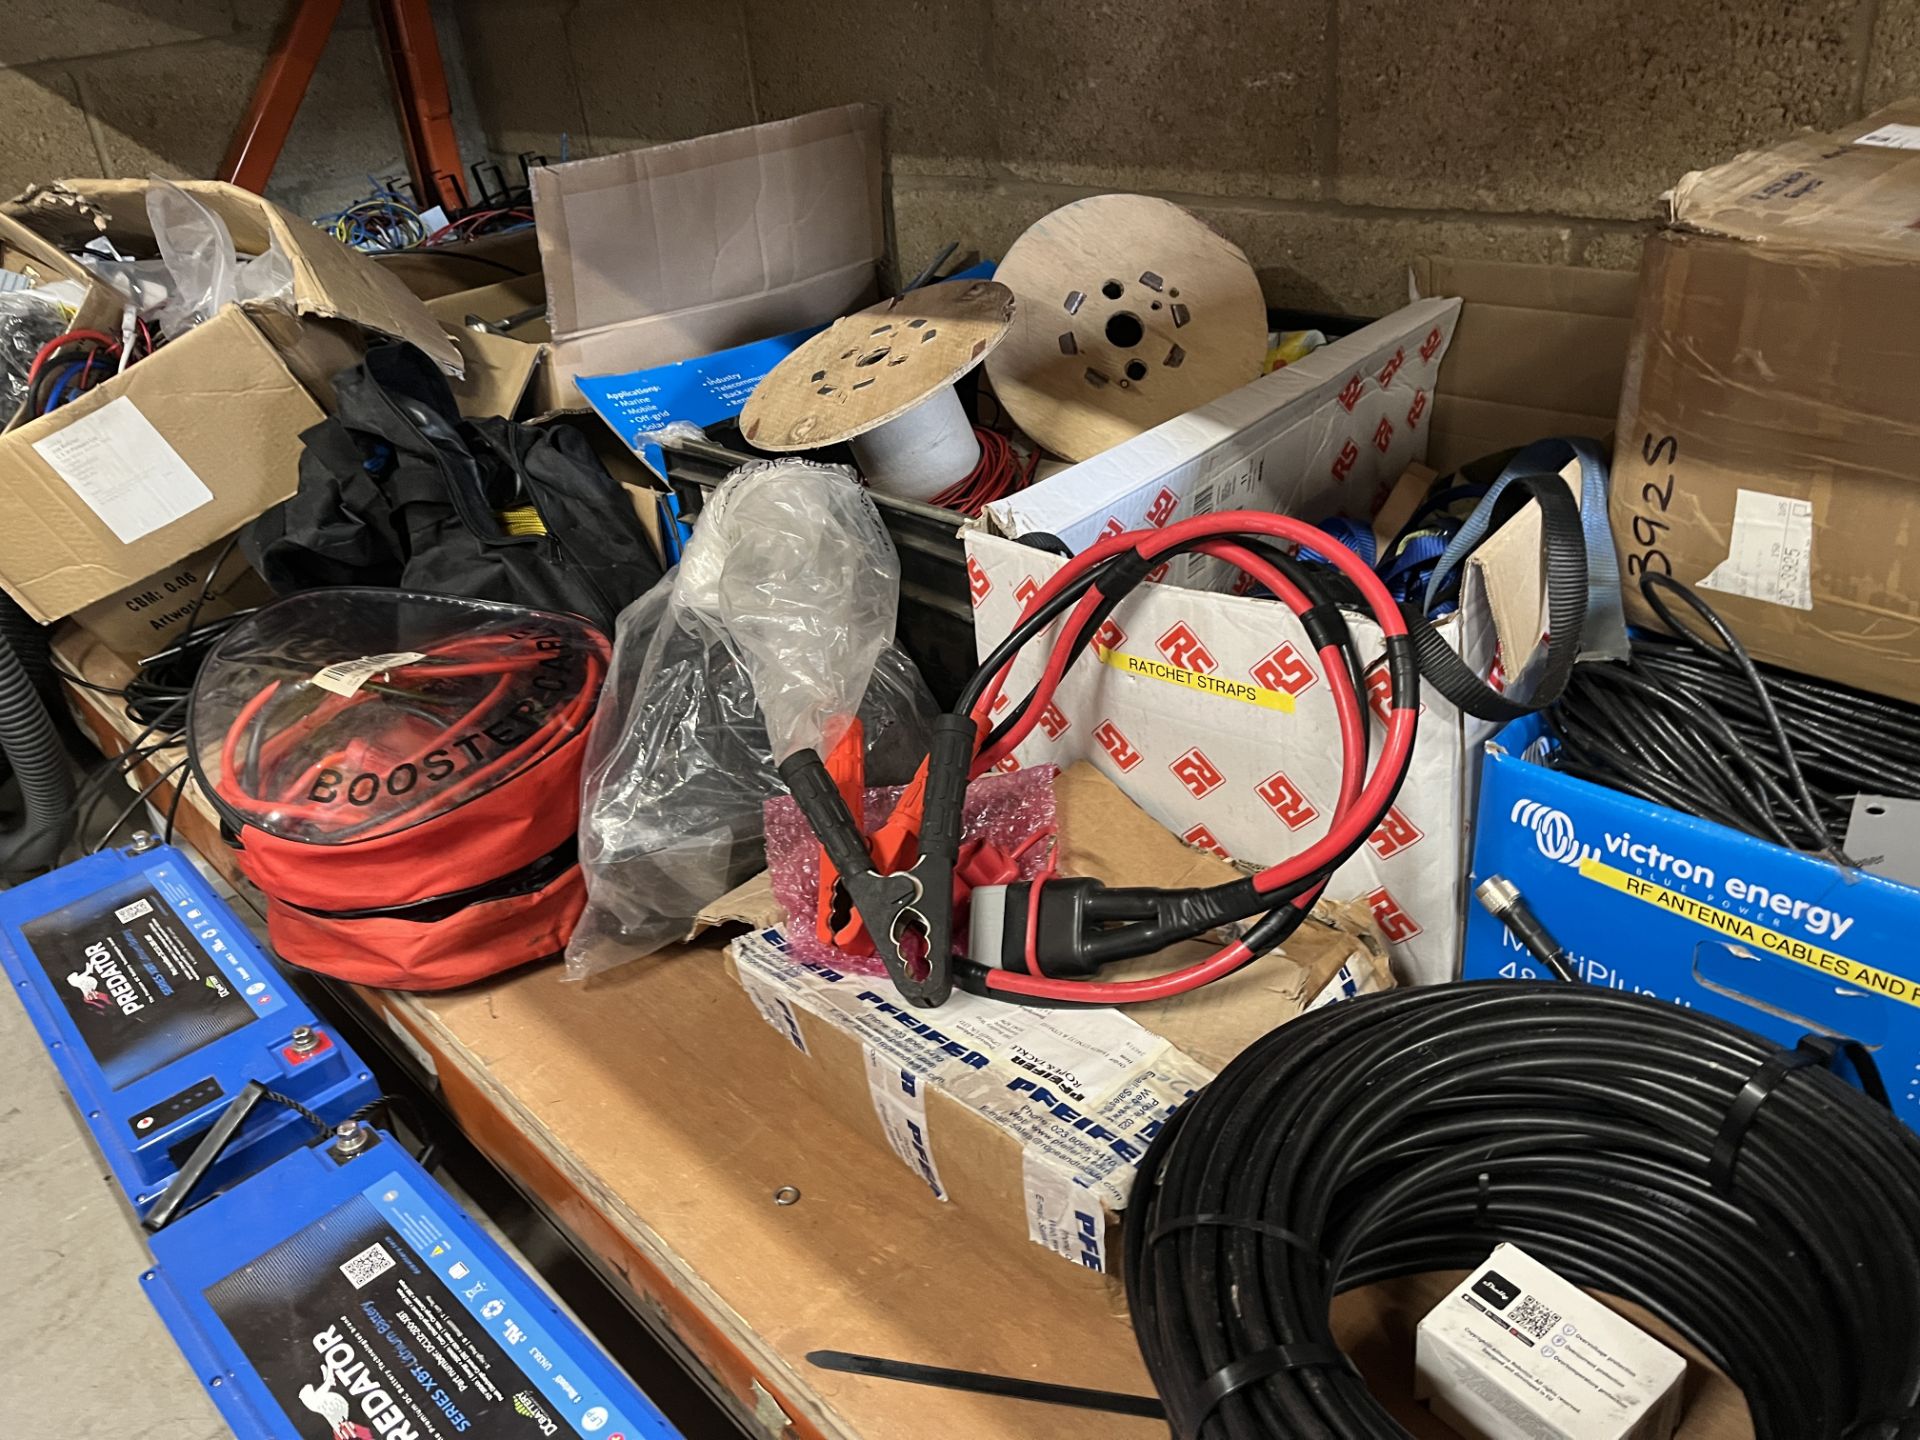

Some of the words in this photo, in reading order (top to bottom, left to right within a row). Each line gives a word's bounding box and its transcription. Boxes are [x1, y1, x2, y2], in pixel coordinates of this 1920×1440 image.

[606, 385, 661, 400] Applications:
[620, 396, 651, 407] Marine
[628, 403, 658, 415] Mobile
[635, 411, 670, 423] Off-grid
[642, 421, 666, 431] Solar
[1330, 439, 1359, 482] RS
[164, 571, 198, 594] 0.06
[1129, 657, 1193, 685] RATCHET
[1197, 673, 1257, 701] STRAPS
[1253, 643, 1316, 696] RS
[306, 699, 542, 808] BOOSTER
[1097, 721, 1141, 770] RS
[1172, 749, 1224, 798] RS
[1258, 774, 1317, 829] RS
[1604, 831, 1715, 889] victron
[1724, 876, 1855, 941] energy
[1635, 867, 1687, 894] BLUE
[1706, 893, 1782, 928] POWER
[1626, 877, 1654, 897] RF
[1656, 892, 1755, 941] ANTENNA
[1761, 931, 1850, 976] CABLES
[1855, 968, 1906, 996] AND
[83, 940, 145, 1016] PREDATOR
[855, 990, 990, 1070] PFEIFER
[1009, 1054, 1085, 1101] PFEIFER
[1055, 1068, 1081, 1088] ROPE
[1006, 1077, 1142, 1170] PFEIFE
[1050, 1124, 1069, 1139] 023
[339, 1315, 356, 1334] brand
[358, 1300, 389, 1334] Battery
[353, 1331, 385, 1370] Technologies
[430, 1349, 456, 1378] number:
[383, 1370, 404, 1393] Battery
[401, 1392, 413, 1404] DC
[450, 1375, 468, 1392] Part
[410, 1403, 436, 1432] Premium
[430, 1388, 471, 1432] SERIES
[515, 1391, 558, 1436] DCBATTERY
